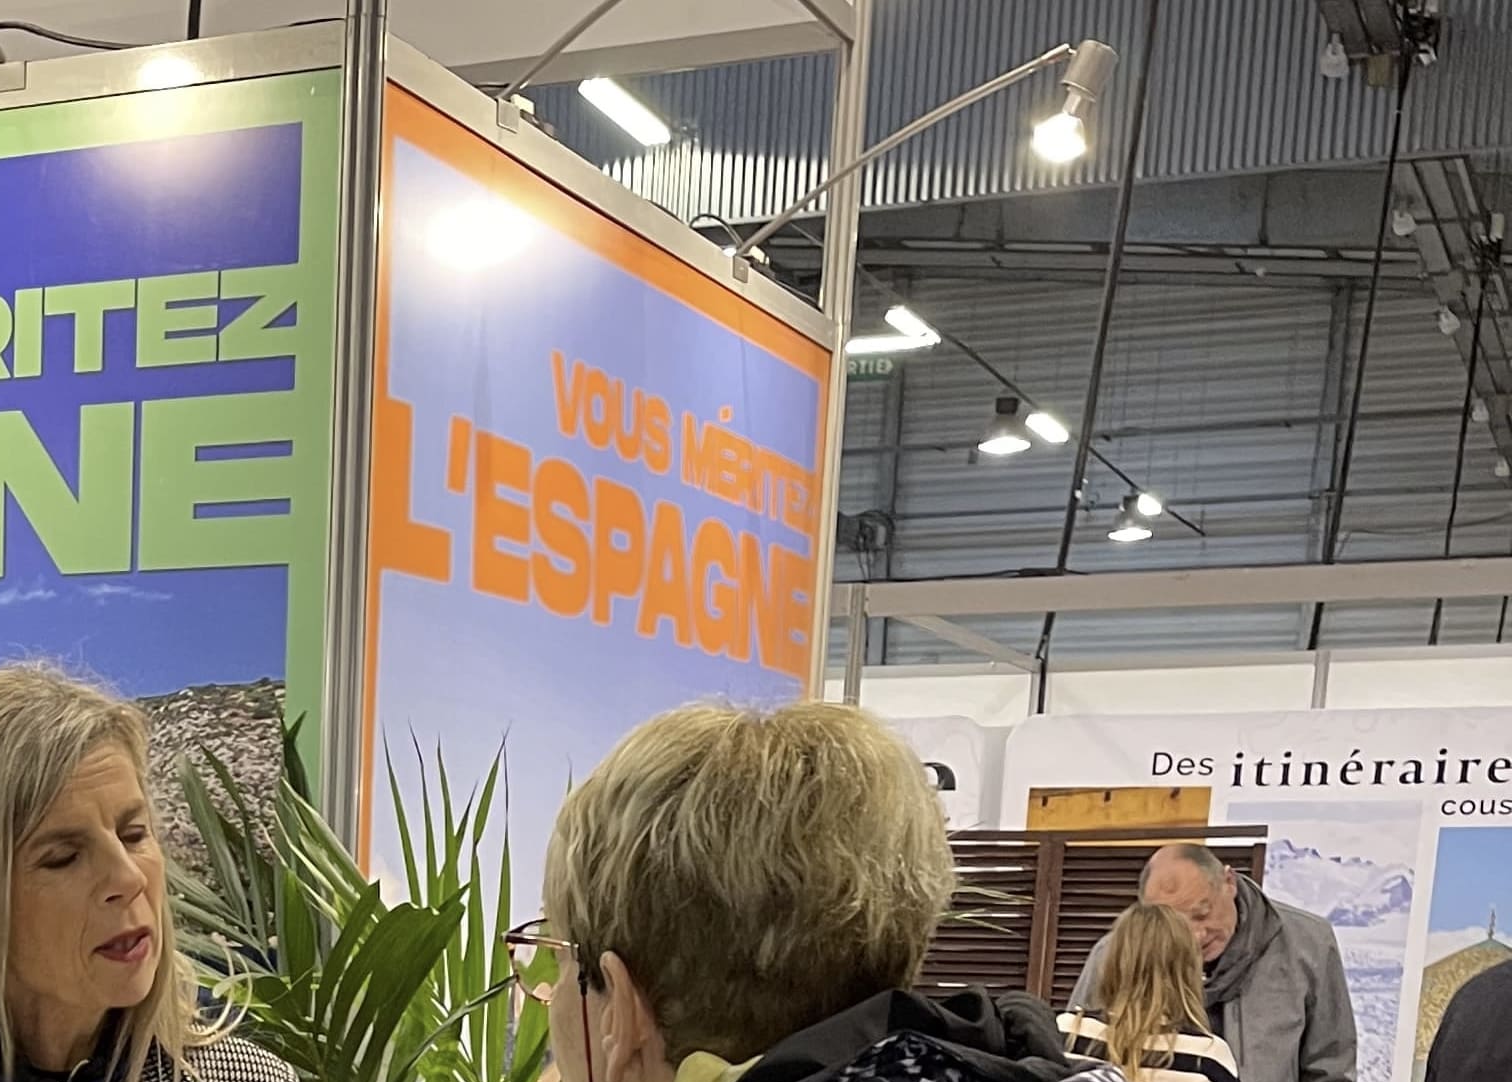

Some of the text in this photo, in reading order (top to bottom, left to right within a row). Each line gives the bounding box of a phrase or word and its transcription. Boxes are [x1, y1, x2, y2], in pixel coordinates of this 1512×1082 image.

[551, 348, 673, 476] VOUS
[376, 397, 811, 680] L'ESPAGNE
[1151, 748, 1512, 787] Des itinéraire
